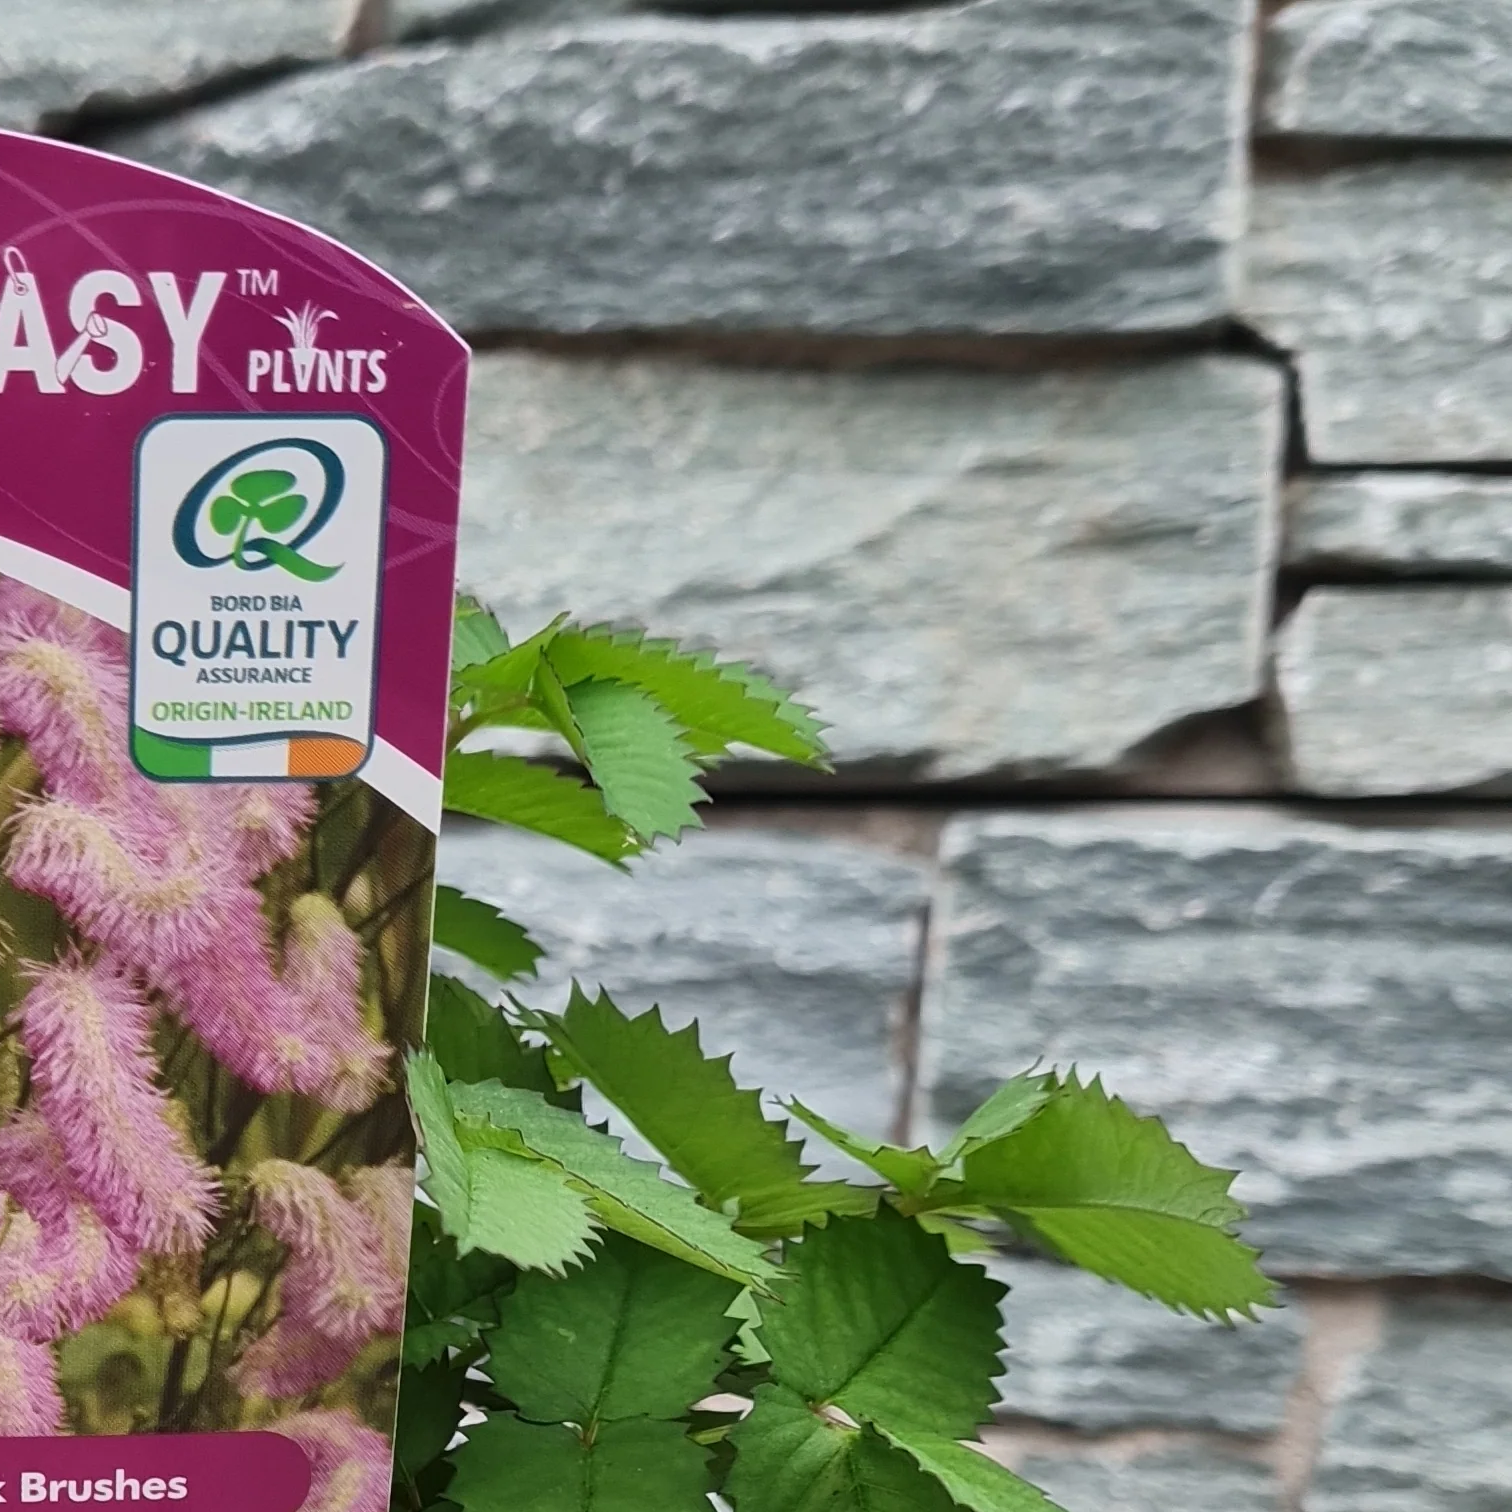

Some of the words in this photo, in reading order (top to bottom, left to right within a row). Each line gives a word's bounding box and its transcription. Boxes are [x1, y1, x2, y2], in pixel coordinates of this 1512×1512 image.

[210, 595, 266, 612] BORD
[270, 595, 303, 612] BIA
[151, 619, 360, 667] QUALITY
[196, 667, 313, 684] ASSURANCE
[151, 701, 353, 722] ORIGIN-IRELAND
[20, 1470, 189, 1503] Brushes
